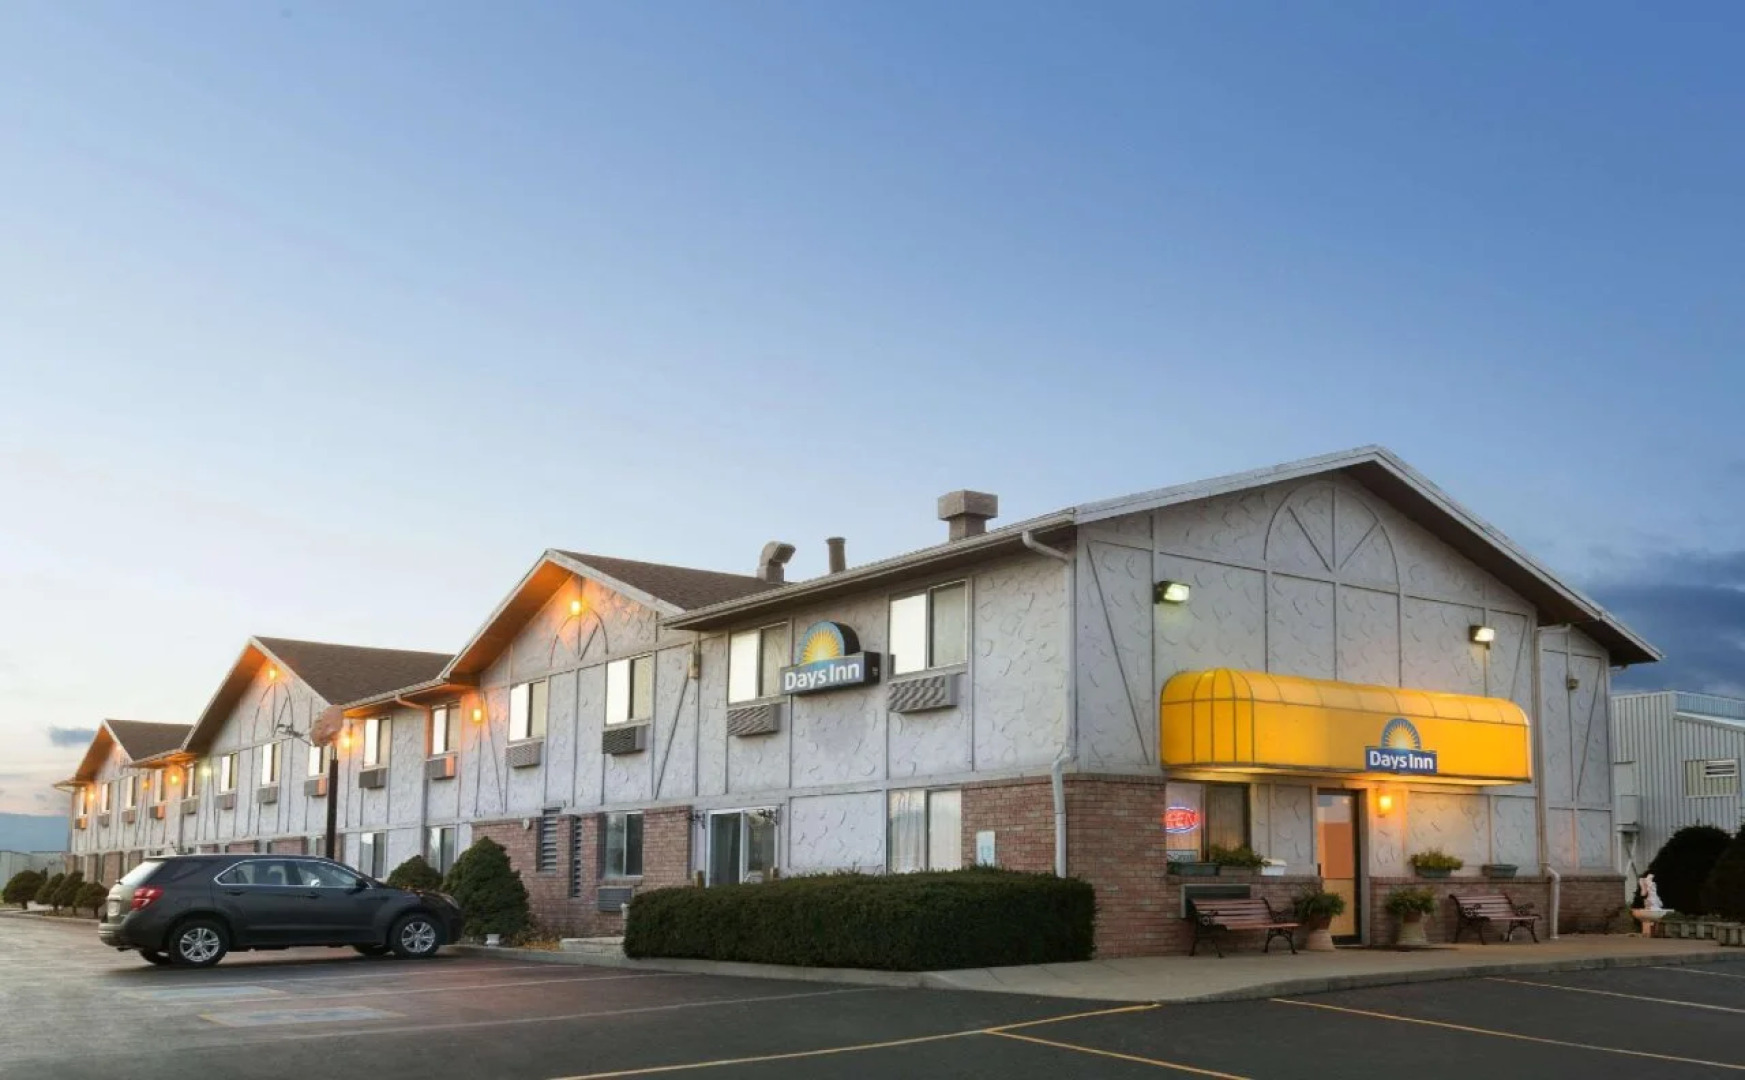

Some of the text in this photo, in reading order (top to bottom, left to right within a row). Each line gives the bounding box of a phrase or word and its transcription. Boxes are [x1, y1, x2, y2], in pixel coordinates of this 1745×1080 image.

[784, 663, 860, 690] Days Inn
[1369, 751, 1434, 770] Days Inn
[1166, 811, 1197, 828] PEN
